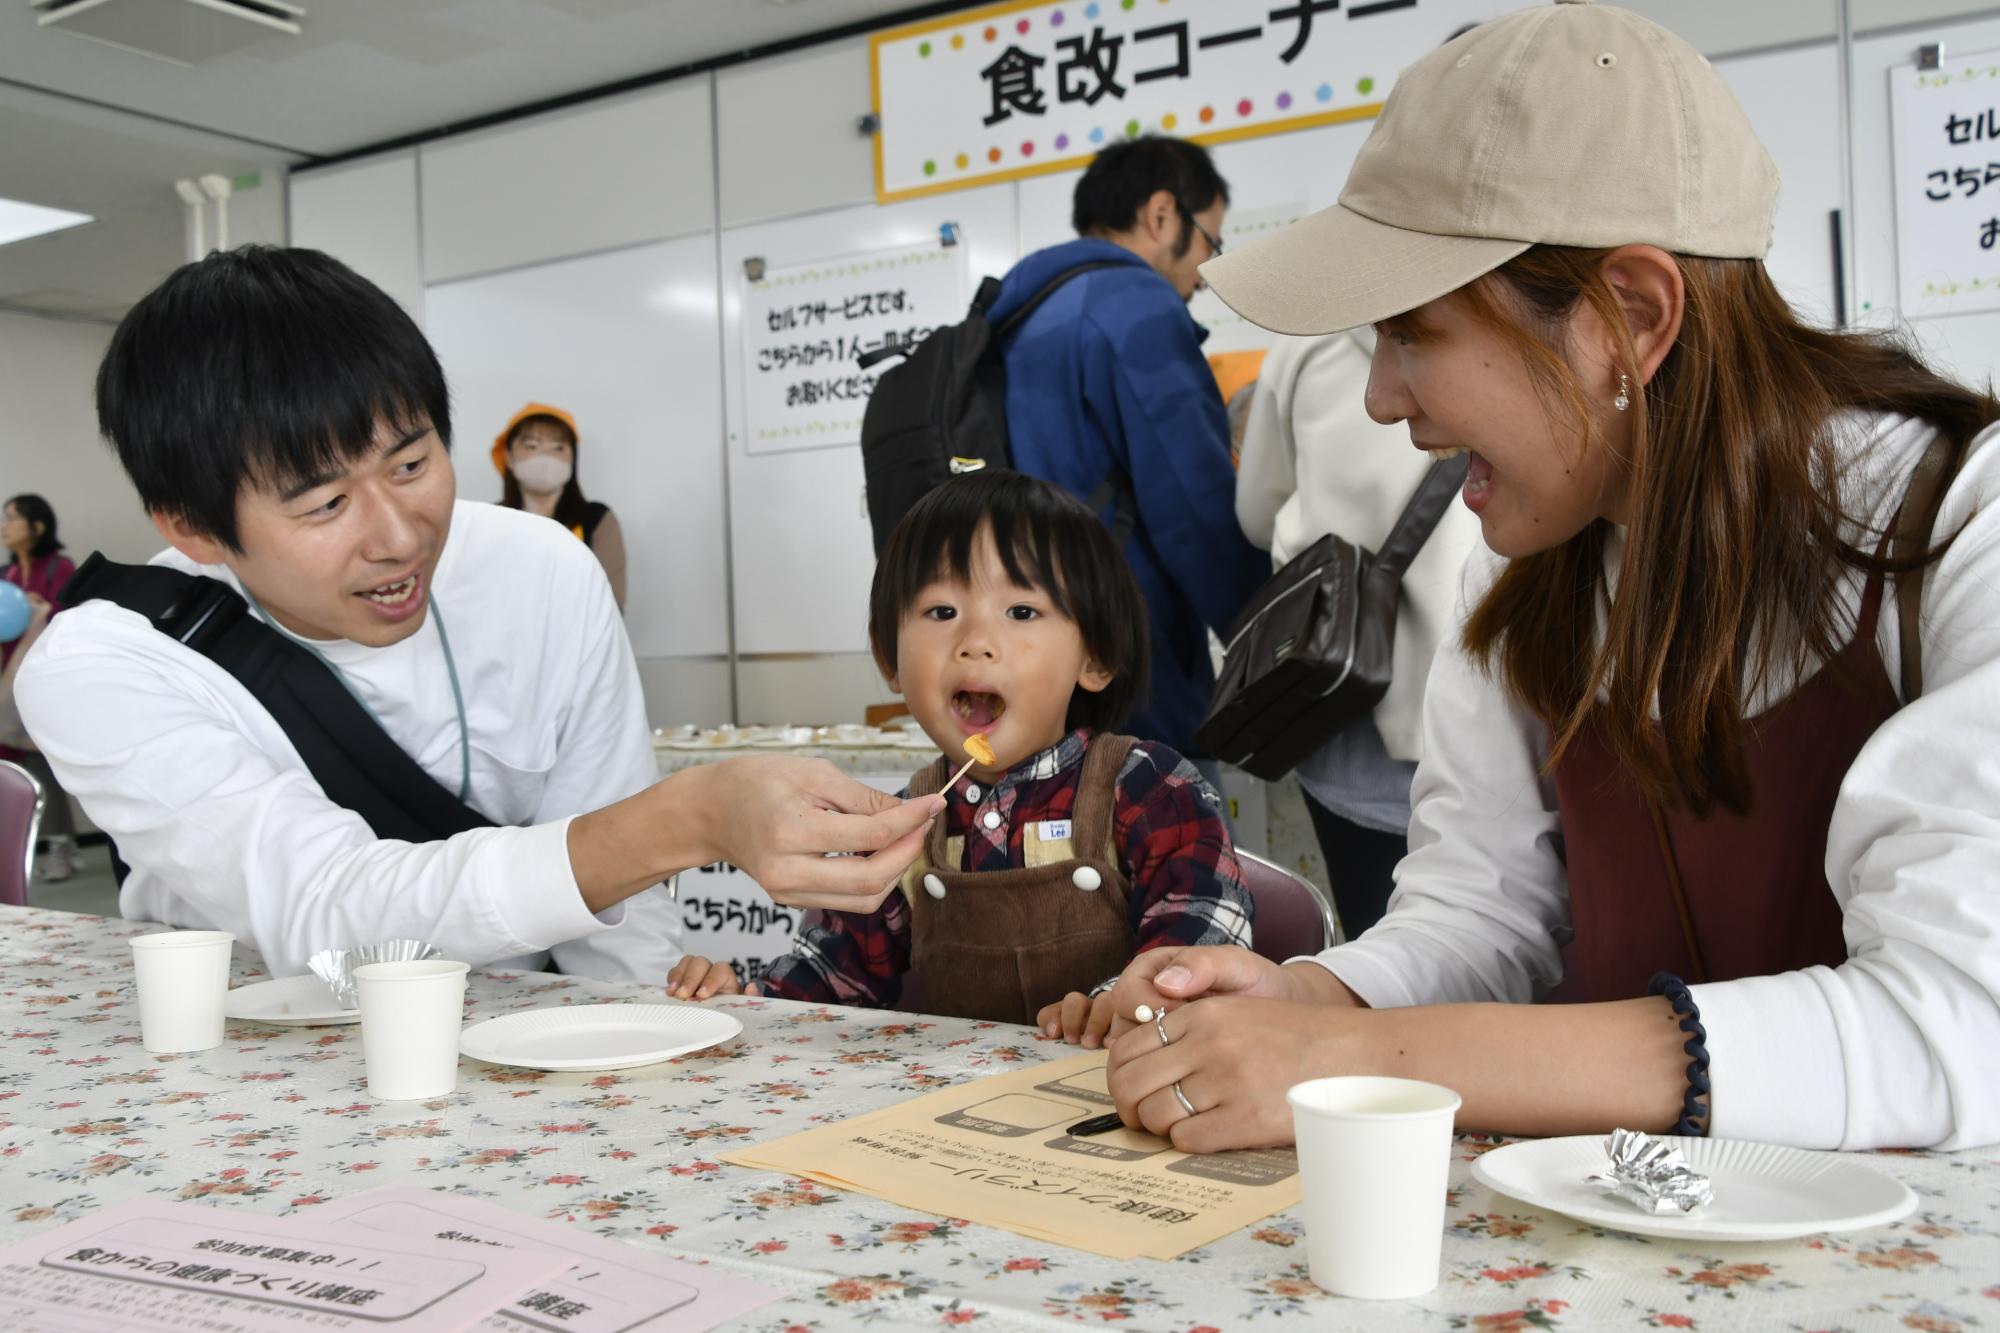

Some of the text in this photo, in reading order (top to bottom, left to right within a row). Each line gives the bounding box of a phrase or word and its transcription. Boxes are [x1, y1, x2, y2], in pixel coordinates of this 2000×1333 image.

[980, 0, 1418, 128] 食改コーナー
[1945, 106, 2000, 145] セル
[683, 898, 792, 933] こちらから
[930, 1161, 1199, 1224] 健康クイズラリー
[64, 1246, 385, 1307] 食からの健康づくり講座
